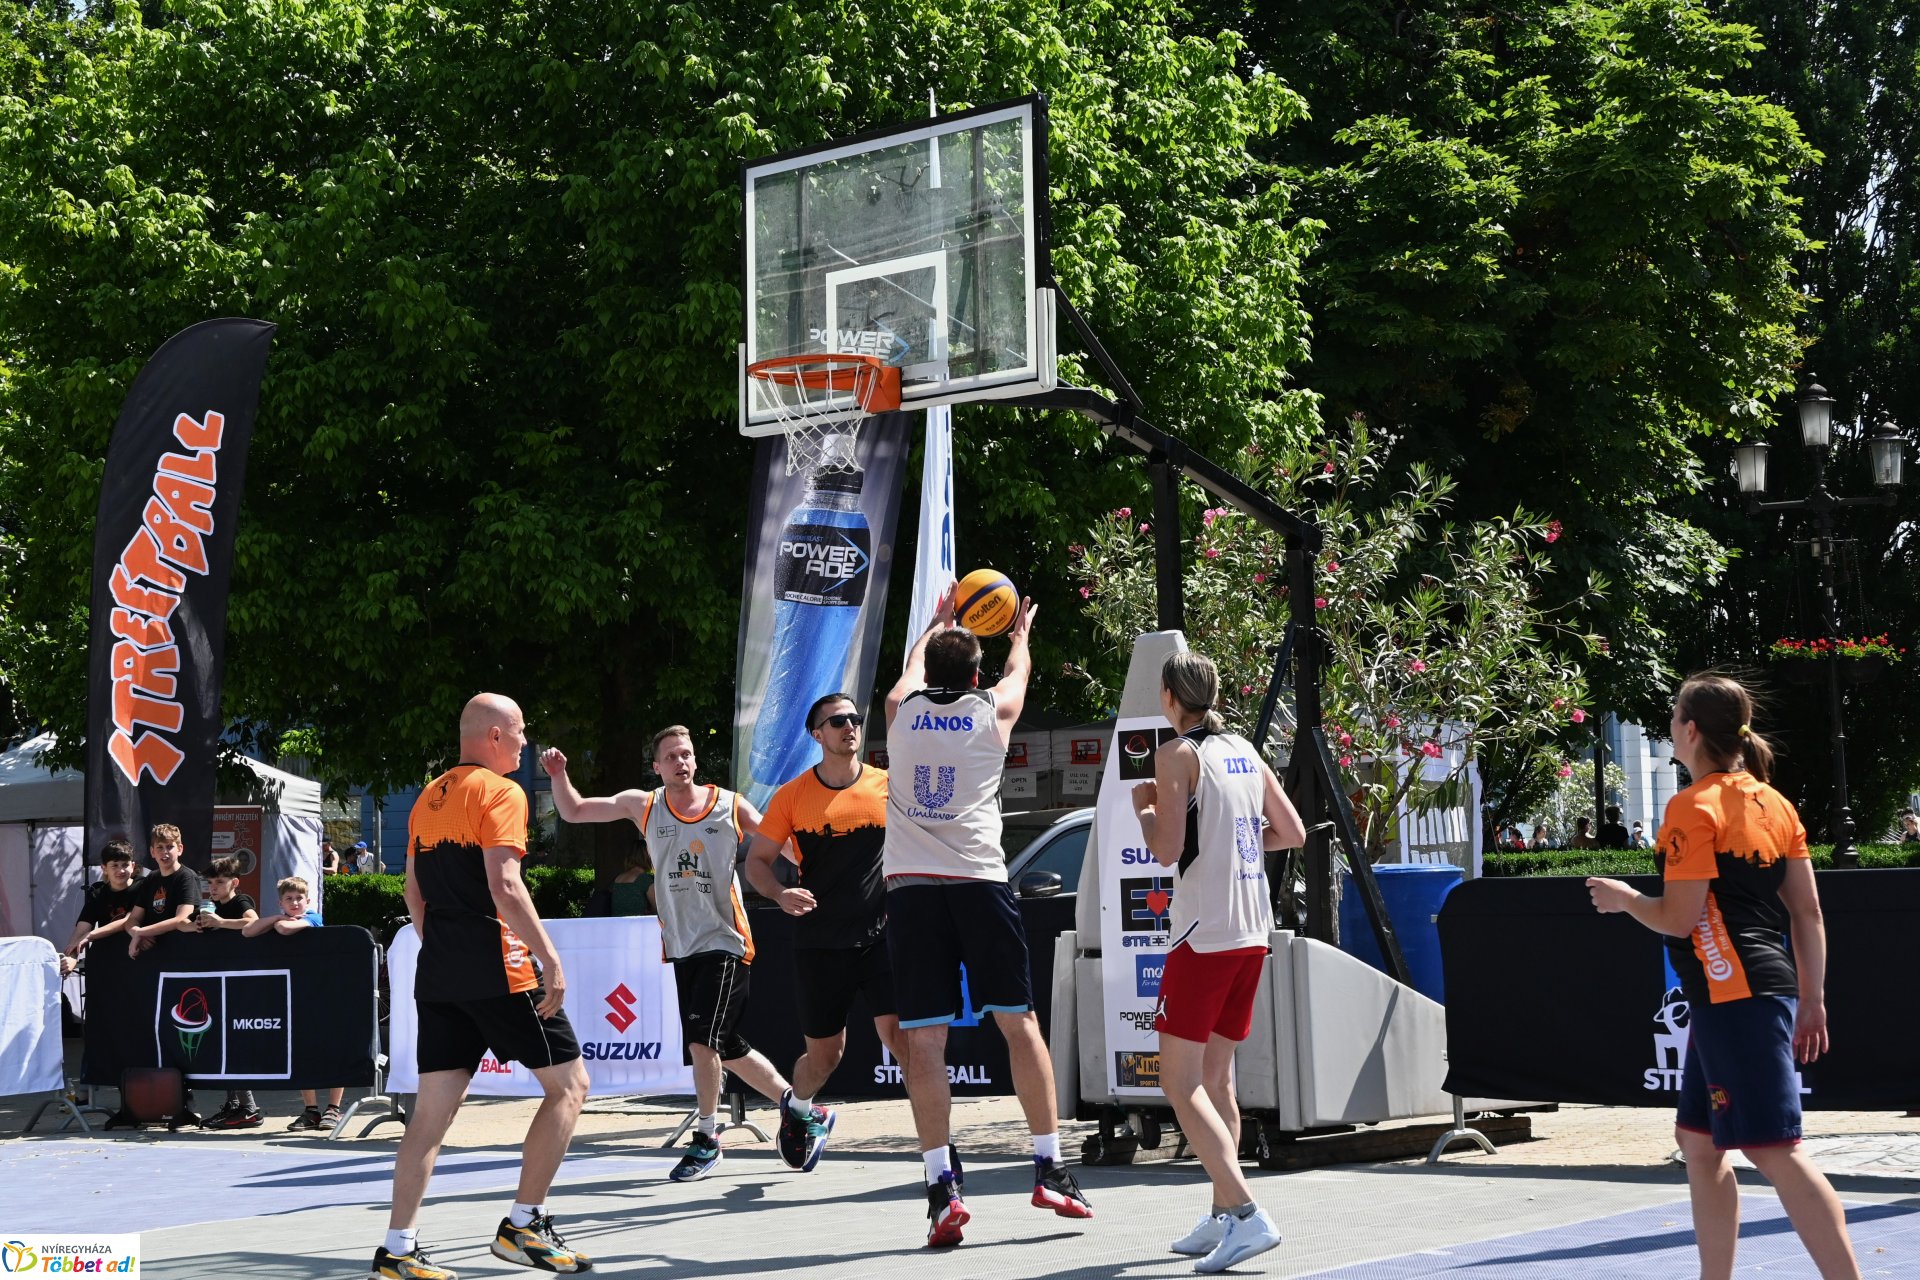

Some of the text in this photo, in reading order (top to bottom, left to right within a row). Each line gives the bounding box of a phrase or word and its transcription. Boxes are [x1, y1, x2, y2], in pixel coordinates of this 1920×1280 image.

[779, 541, 859, 562] POWER
[805, 559, 856, 579] ADE
[108, 410, 225, 786] STREETBALL
[968, 594, 1002, 623] molten
[911, 710, 973, 731] JÁNOS
[1223, 757, 1257, 774] ZITA
[233, 1018, 282, 1030] MKOSZ
[581, 1041, 662, 1060] SUZUKI
